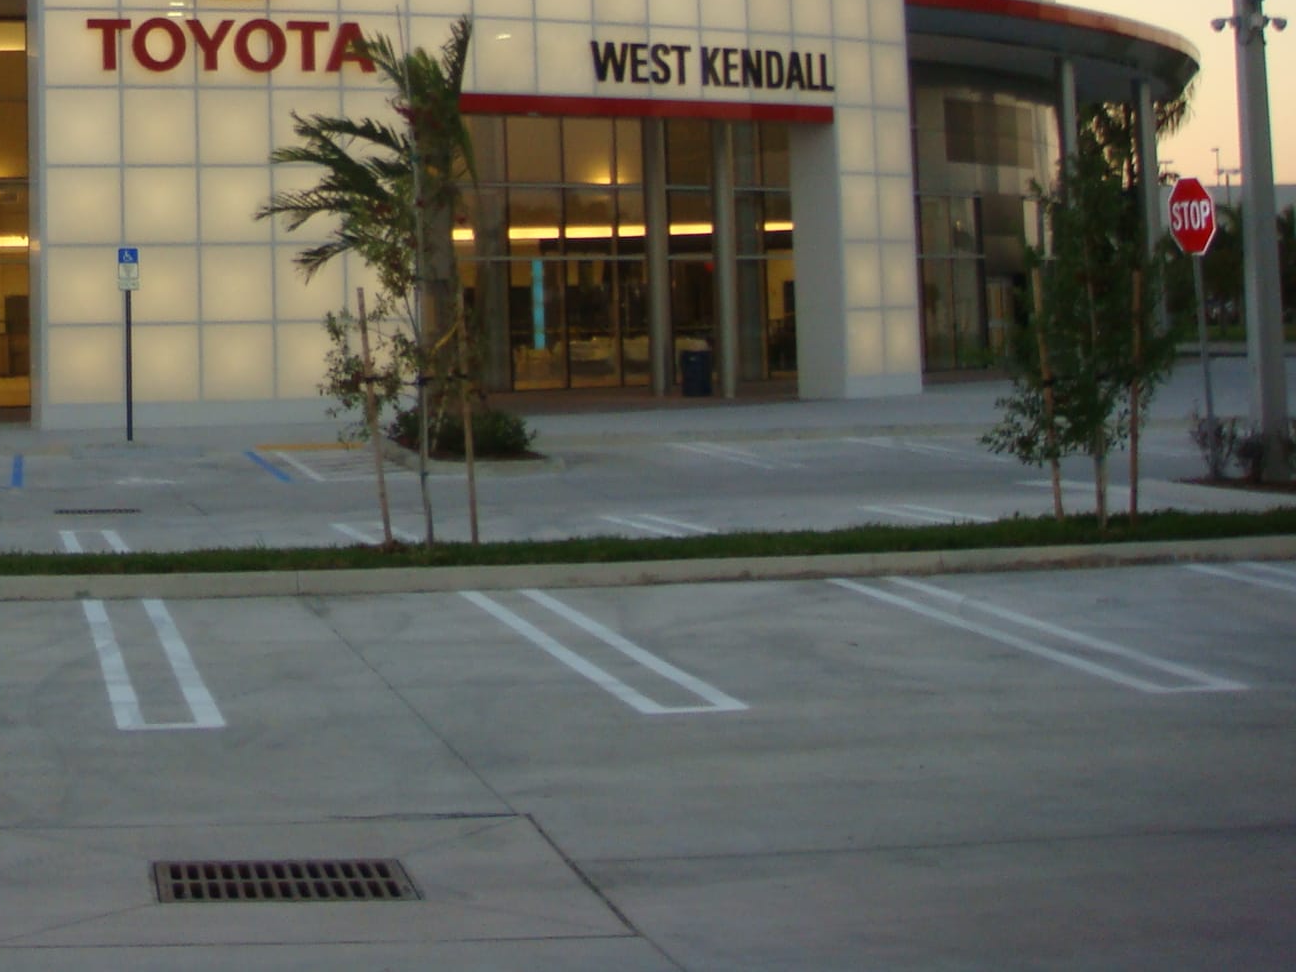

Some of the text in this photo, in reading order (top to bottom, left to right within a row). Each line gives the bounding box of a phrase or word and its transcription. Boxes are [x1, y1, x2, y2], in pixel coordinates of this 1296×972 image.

[86, 17, 376, 73] TOYOTA
[590, 40, 835, 92] WEST KENDALL
[1171, 199, 1210, 231] STOP
